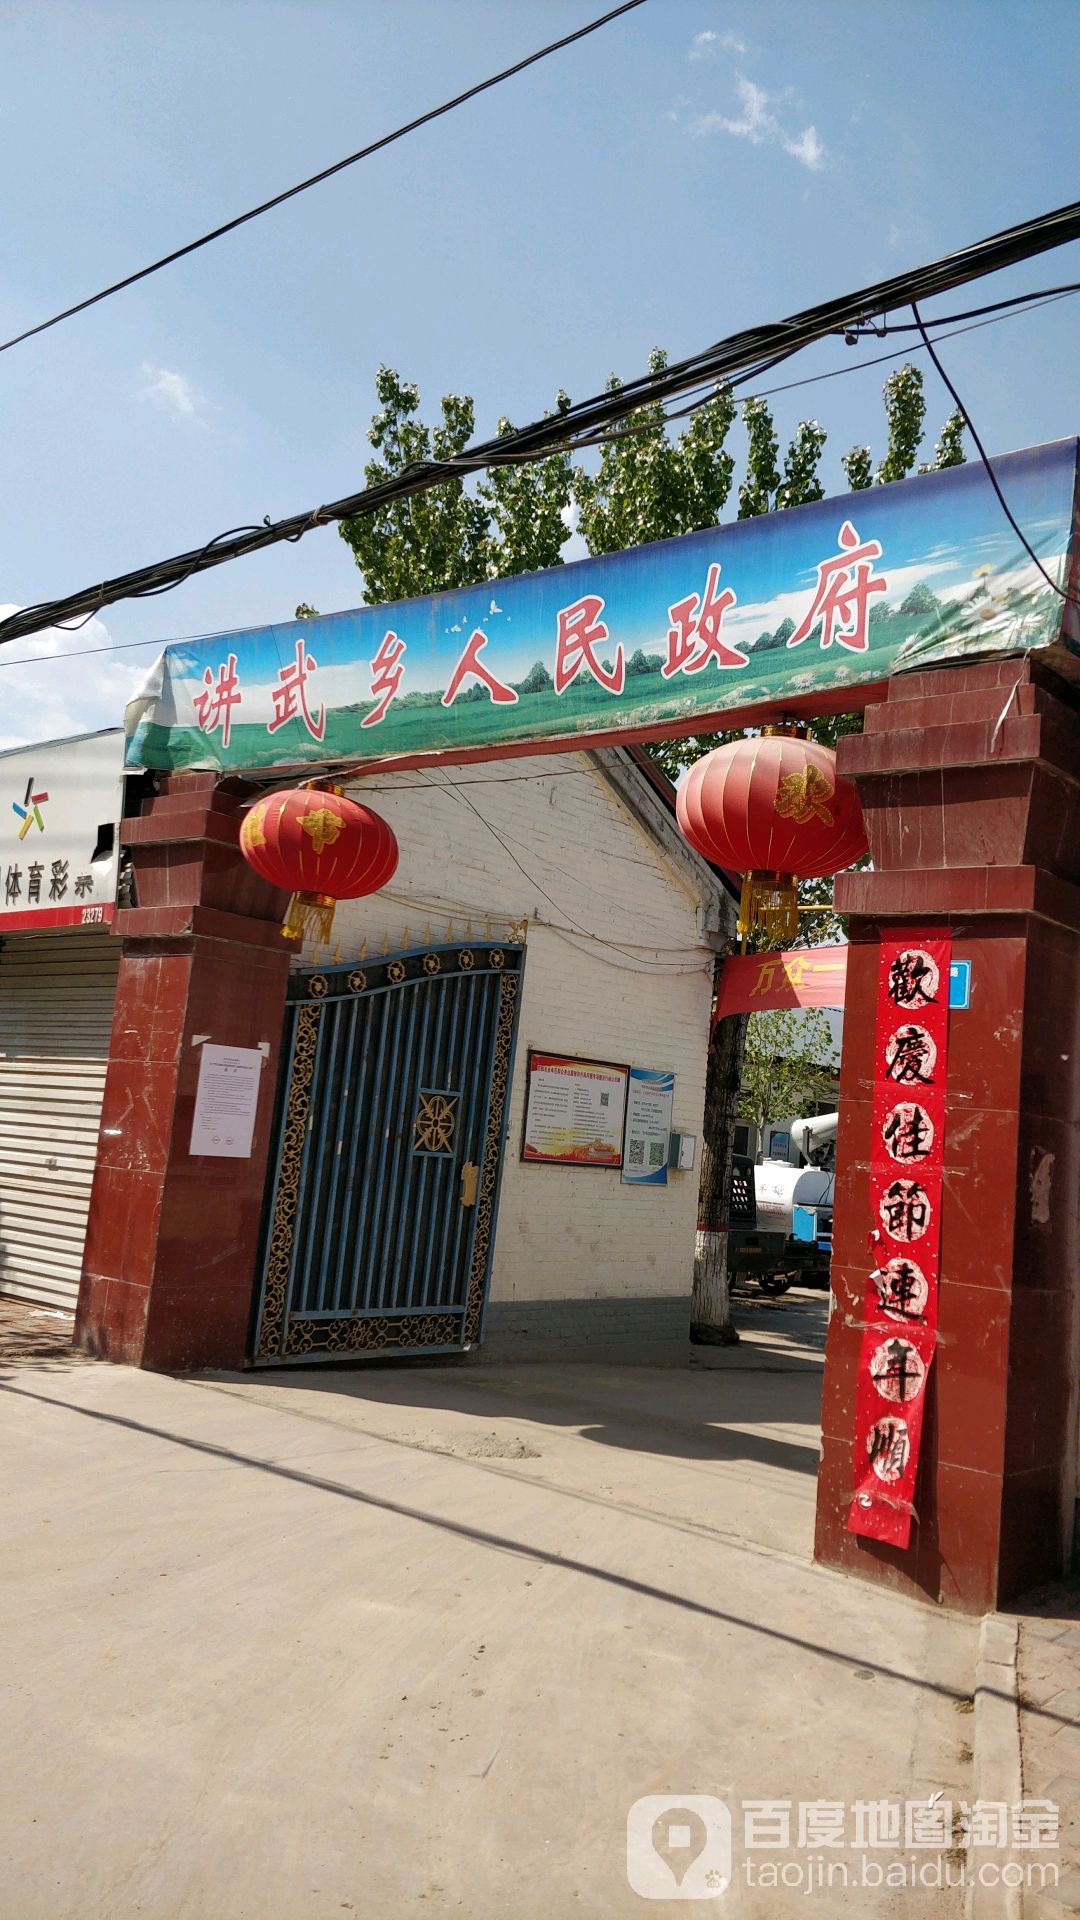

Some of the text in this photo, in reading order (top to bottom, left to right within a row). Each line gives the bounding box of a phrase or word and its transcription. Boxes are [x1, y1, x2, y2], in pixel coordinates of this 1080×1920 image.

[193, 520, 888, 749] 讲武乡人民政府
[81, 907, 103, 924] 23279
